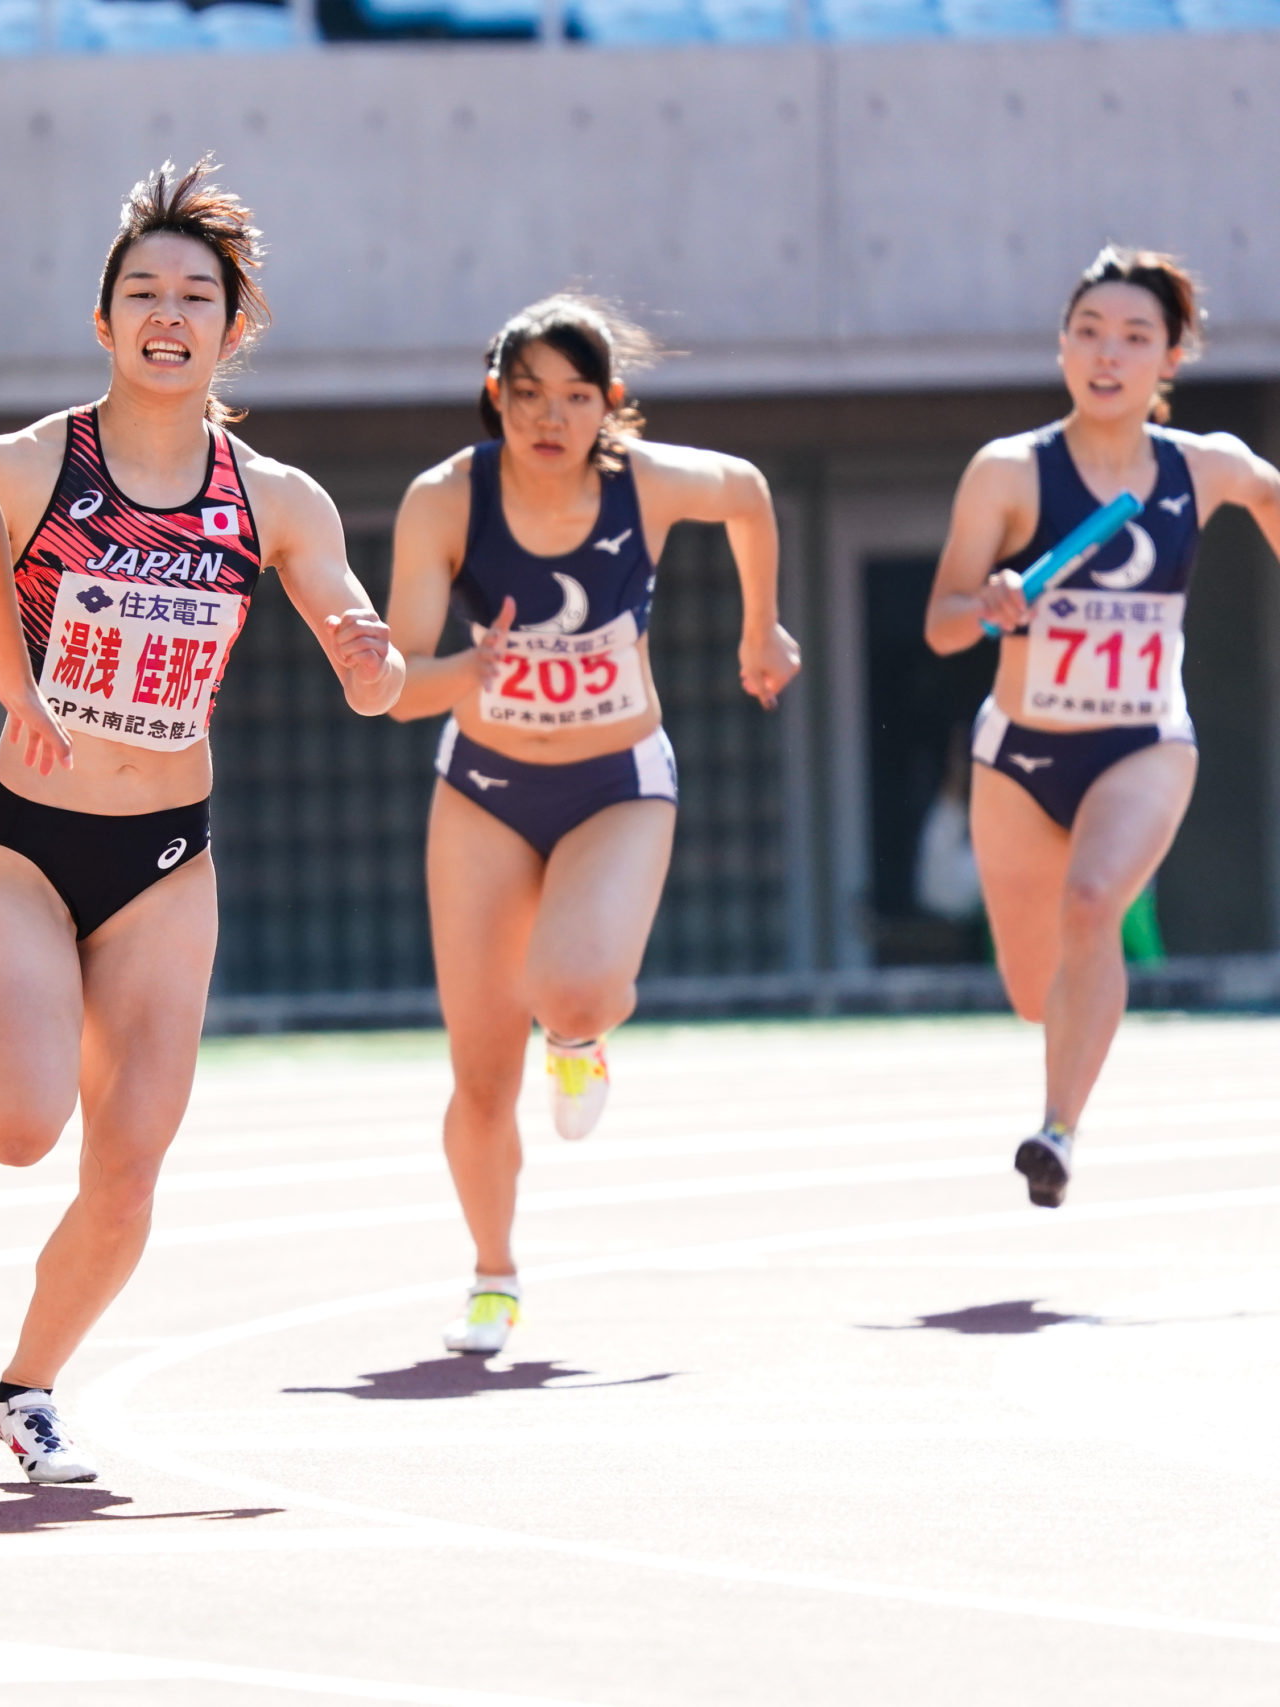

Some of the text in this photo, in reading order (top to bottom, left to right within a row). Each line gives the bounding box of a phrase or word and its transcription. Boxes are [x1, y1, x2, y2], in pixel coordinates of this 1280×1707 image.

[86, 543, 224, 582] JAPAN
[119, 591, 222, 626] 住友電工
[52, 619, 218, 711] 湯浅 佳那子
[499, 650, 618, 704] 205
[1047, 625, 1163, 692] 711
[46, 696, 197, 741] GP木南記念陸上
